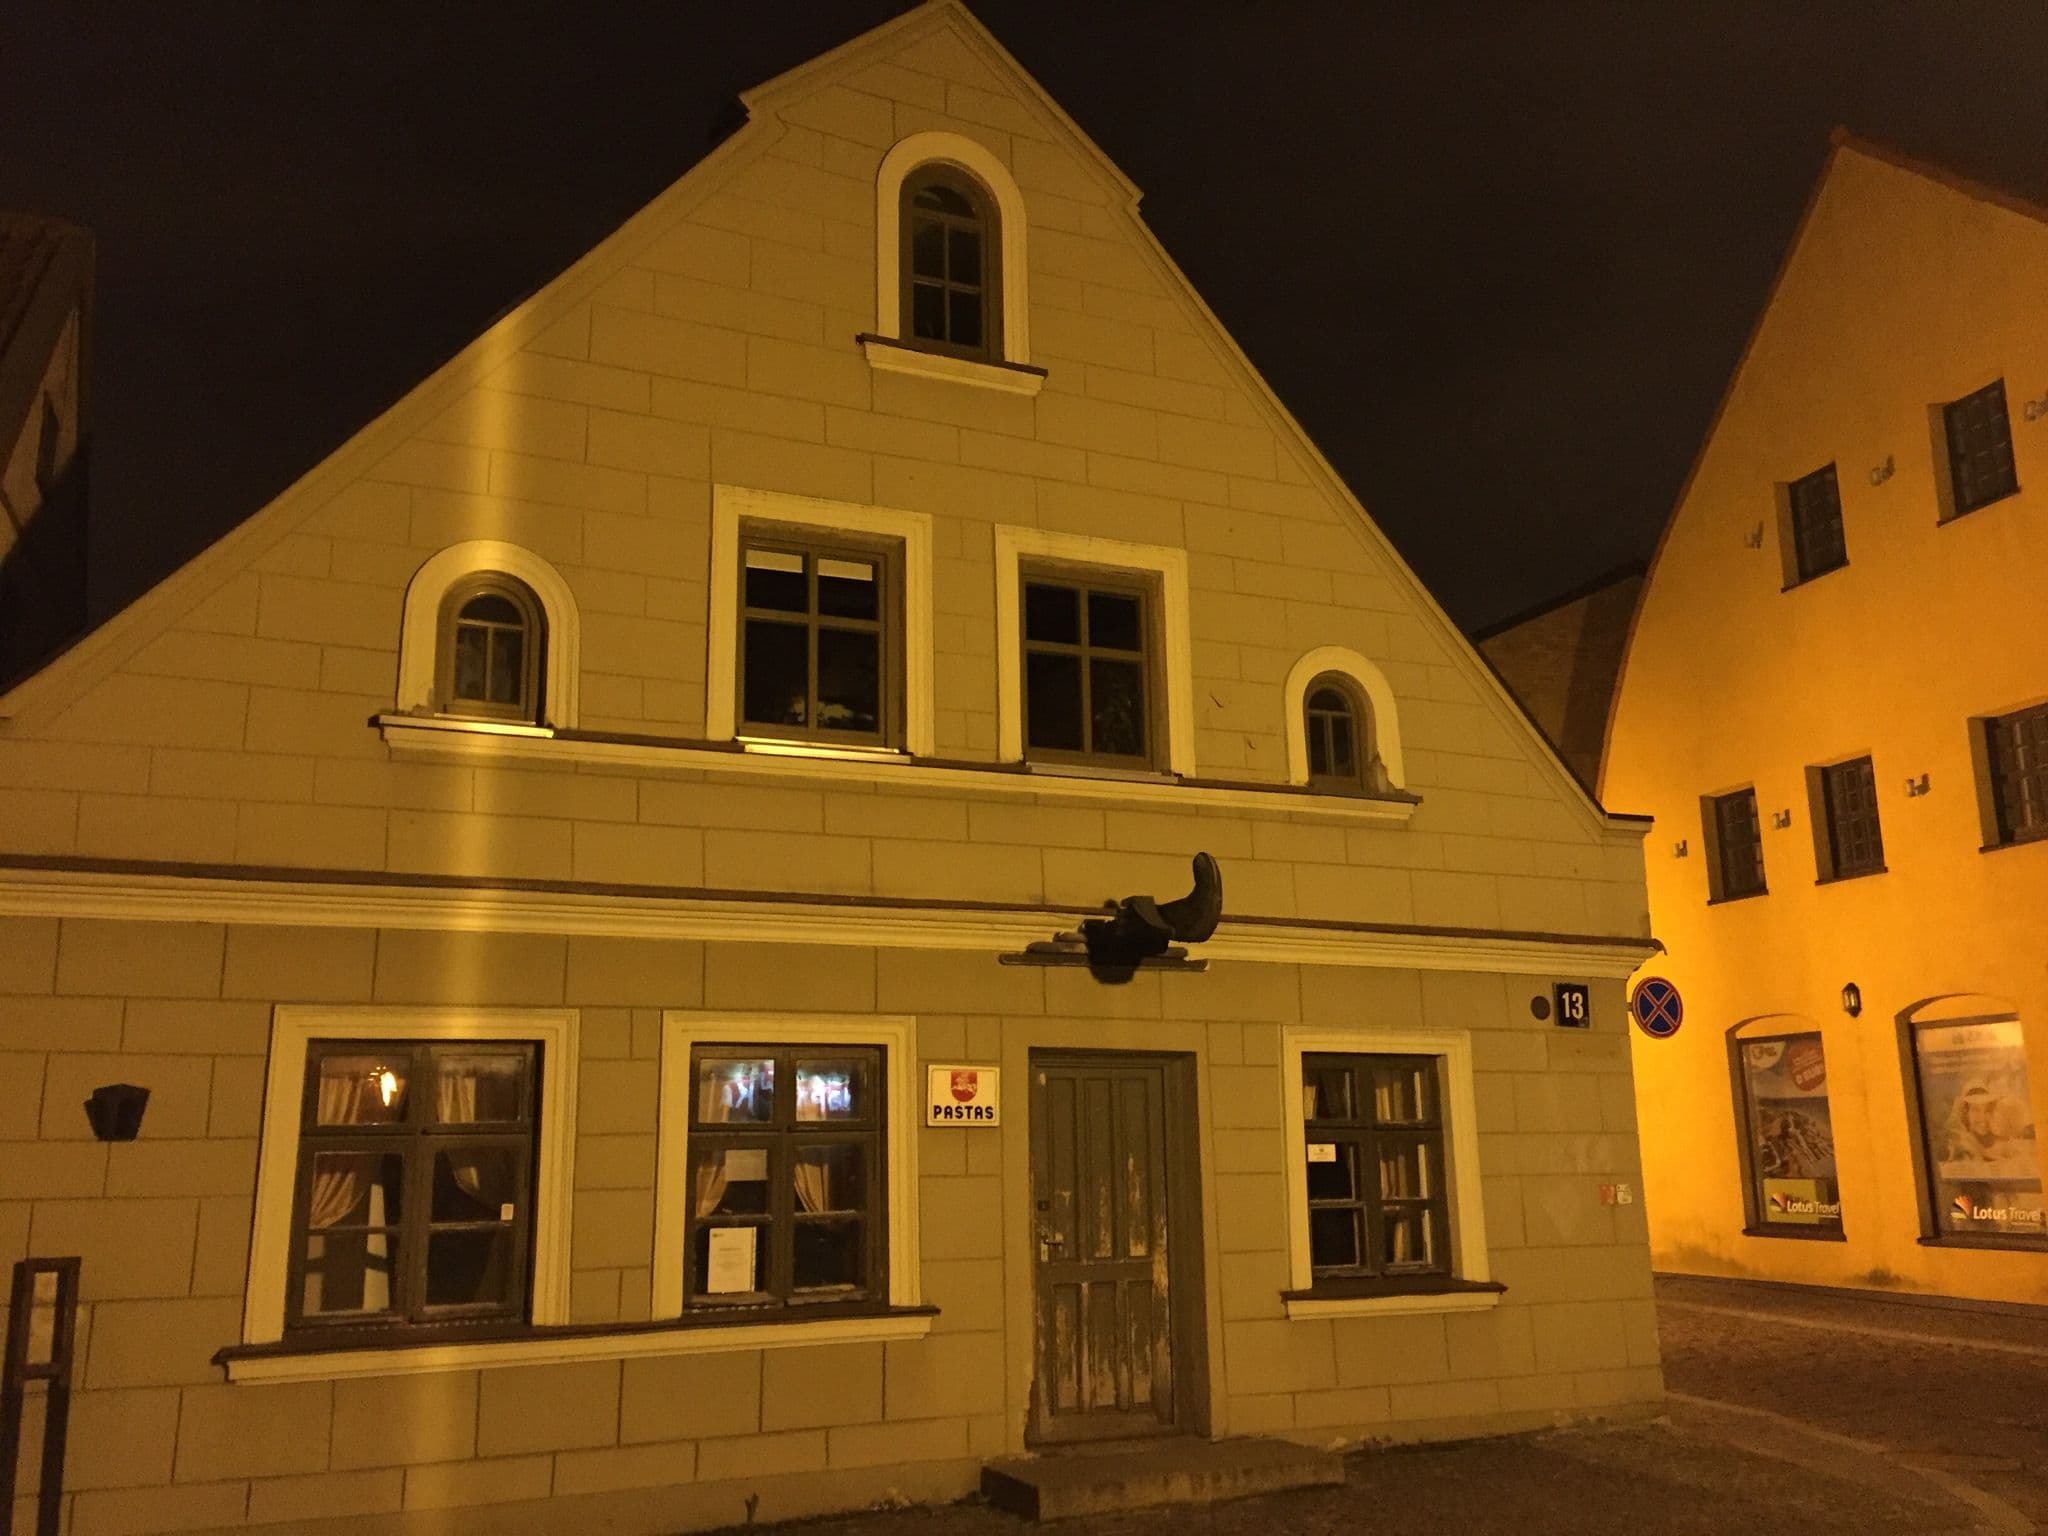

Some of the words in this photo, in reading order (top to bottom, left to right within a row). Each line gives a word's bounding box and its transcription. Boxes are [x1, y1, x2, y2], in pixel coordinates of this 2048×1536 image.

[1562, 992, 1584, 1019] 13
[1787, 1200, 1814, 1213] Lotus
[1815, 1201, 1840, 1214] Travel
[1973, 1205, 2008, 1220] Lotus
